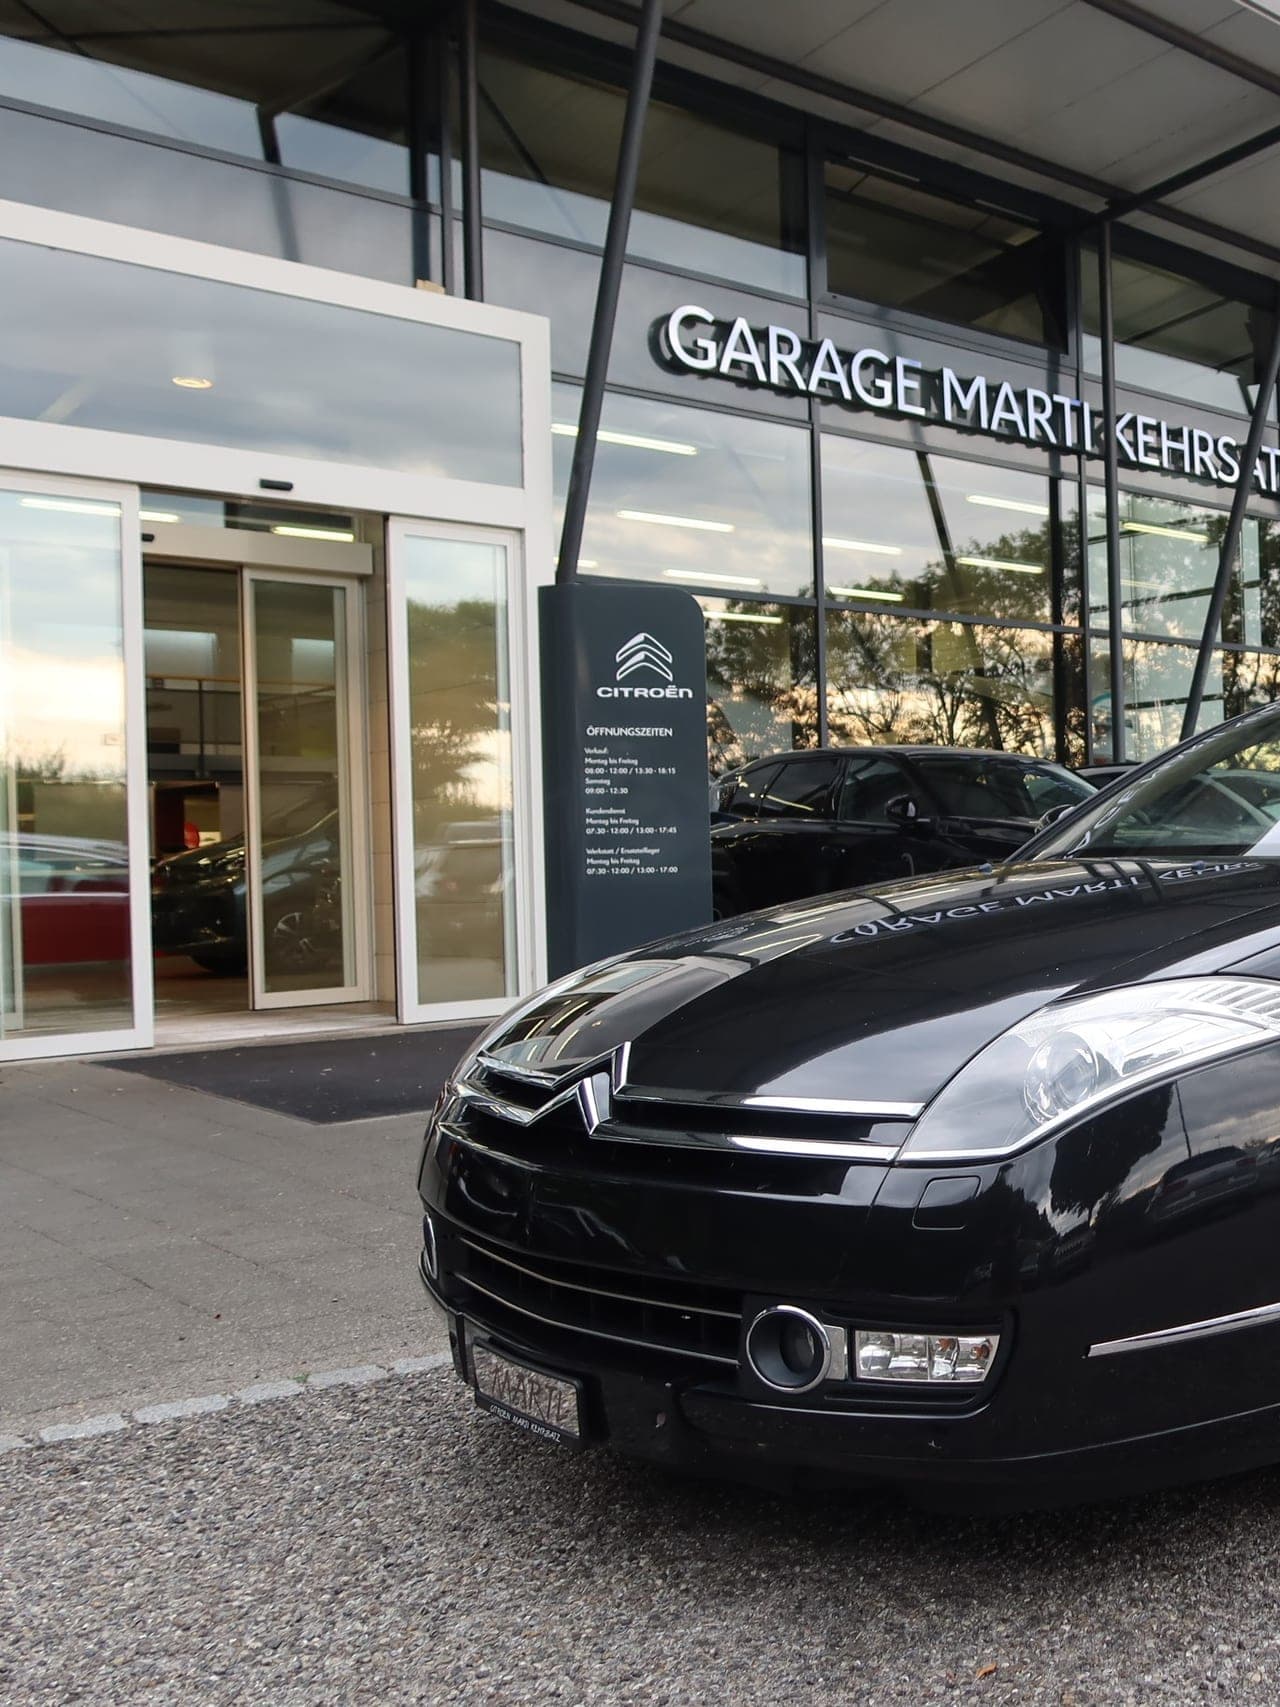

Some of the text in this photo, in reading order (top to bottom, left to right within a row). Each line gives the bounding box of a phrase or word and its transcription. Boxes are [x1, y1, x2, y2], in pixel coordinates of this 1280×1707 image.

[666, 304, 926, 416] GARAGE
[941, 375, 1092, 453] MARTI
[597, 684, 693, 699] CITROËN
[586, 725, 673, 738] ÖFFNUNGSZEITEN
[584, 757, 608, 766] Montag
[618, 757, 638, 766] Freitag
[585, 817, 609, 826] Montag
[619, 817, 640, 826] Freitag
[586, 857, 610, 866] Montag
[620, 857, 641, 866] Freitag
